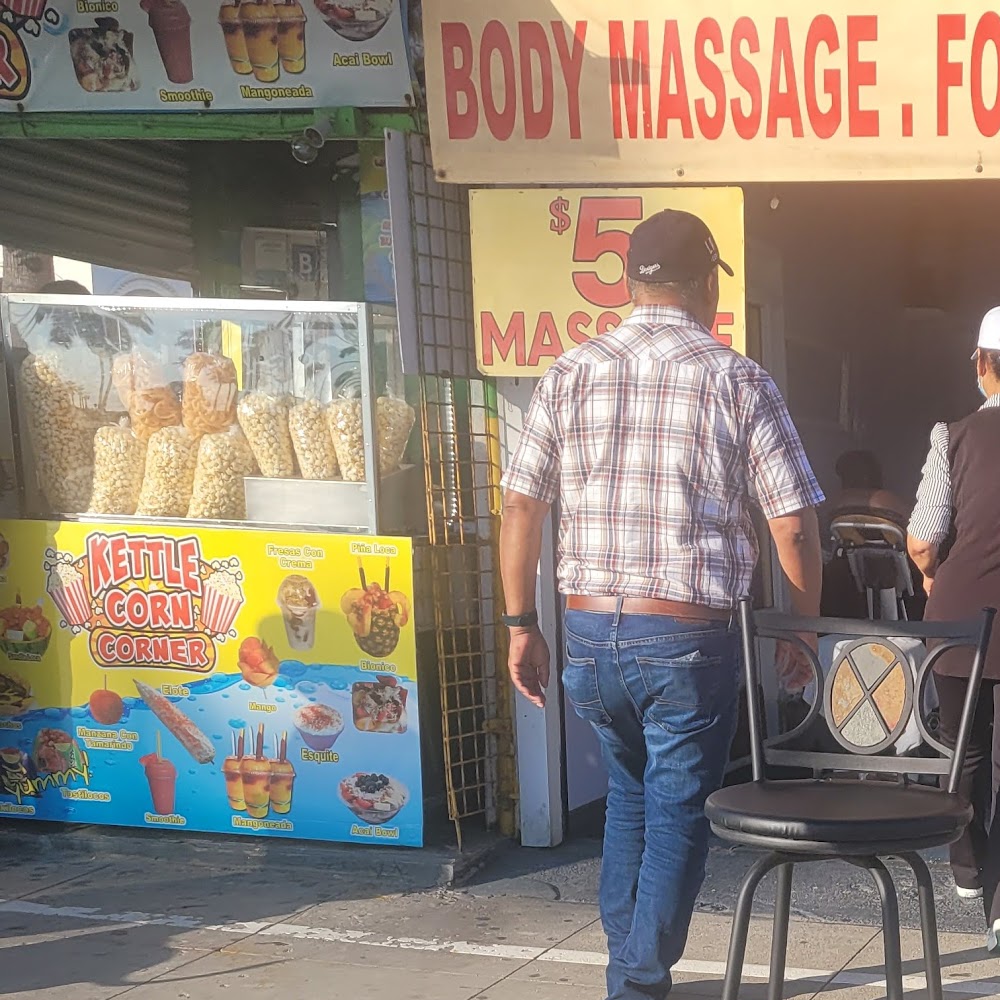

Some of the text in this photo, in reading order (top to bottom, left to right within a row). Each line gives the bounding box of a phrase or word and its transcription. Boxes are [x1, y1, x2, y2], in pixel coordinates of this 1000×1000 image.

[76, 0, 119, 13] Bionico
[333, 52, 394, 67] Acai Bowl
[441, 19, 588, 141] BODY
[608, 15, 880, 141] MASSAGE
[159, 89, 214, 103] Smoothie
[240, 85, 313, 101] Mangoneada
[267, 545, 324, 558] Fresas Con
[374, 544, 397, 555] Loca
[89, 534, 203, 599] KETTLE
[279, 558, 313, 569] Crema
[104, 589, 195, 630] CORN
[97, 633, 209, 667] CORNER
[360, 660, 397, 672] Bionico
[161, 685, 190, 697] Elote
[248, 702, 277, 713] Mango
[301, 748, 340, 765] Esquite
[145, 814, 186, 826] Smoothie
[232, 816, 293, 831] Mangoneada
[351, 825, 399, 838] Acai Bowl
